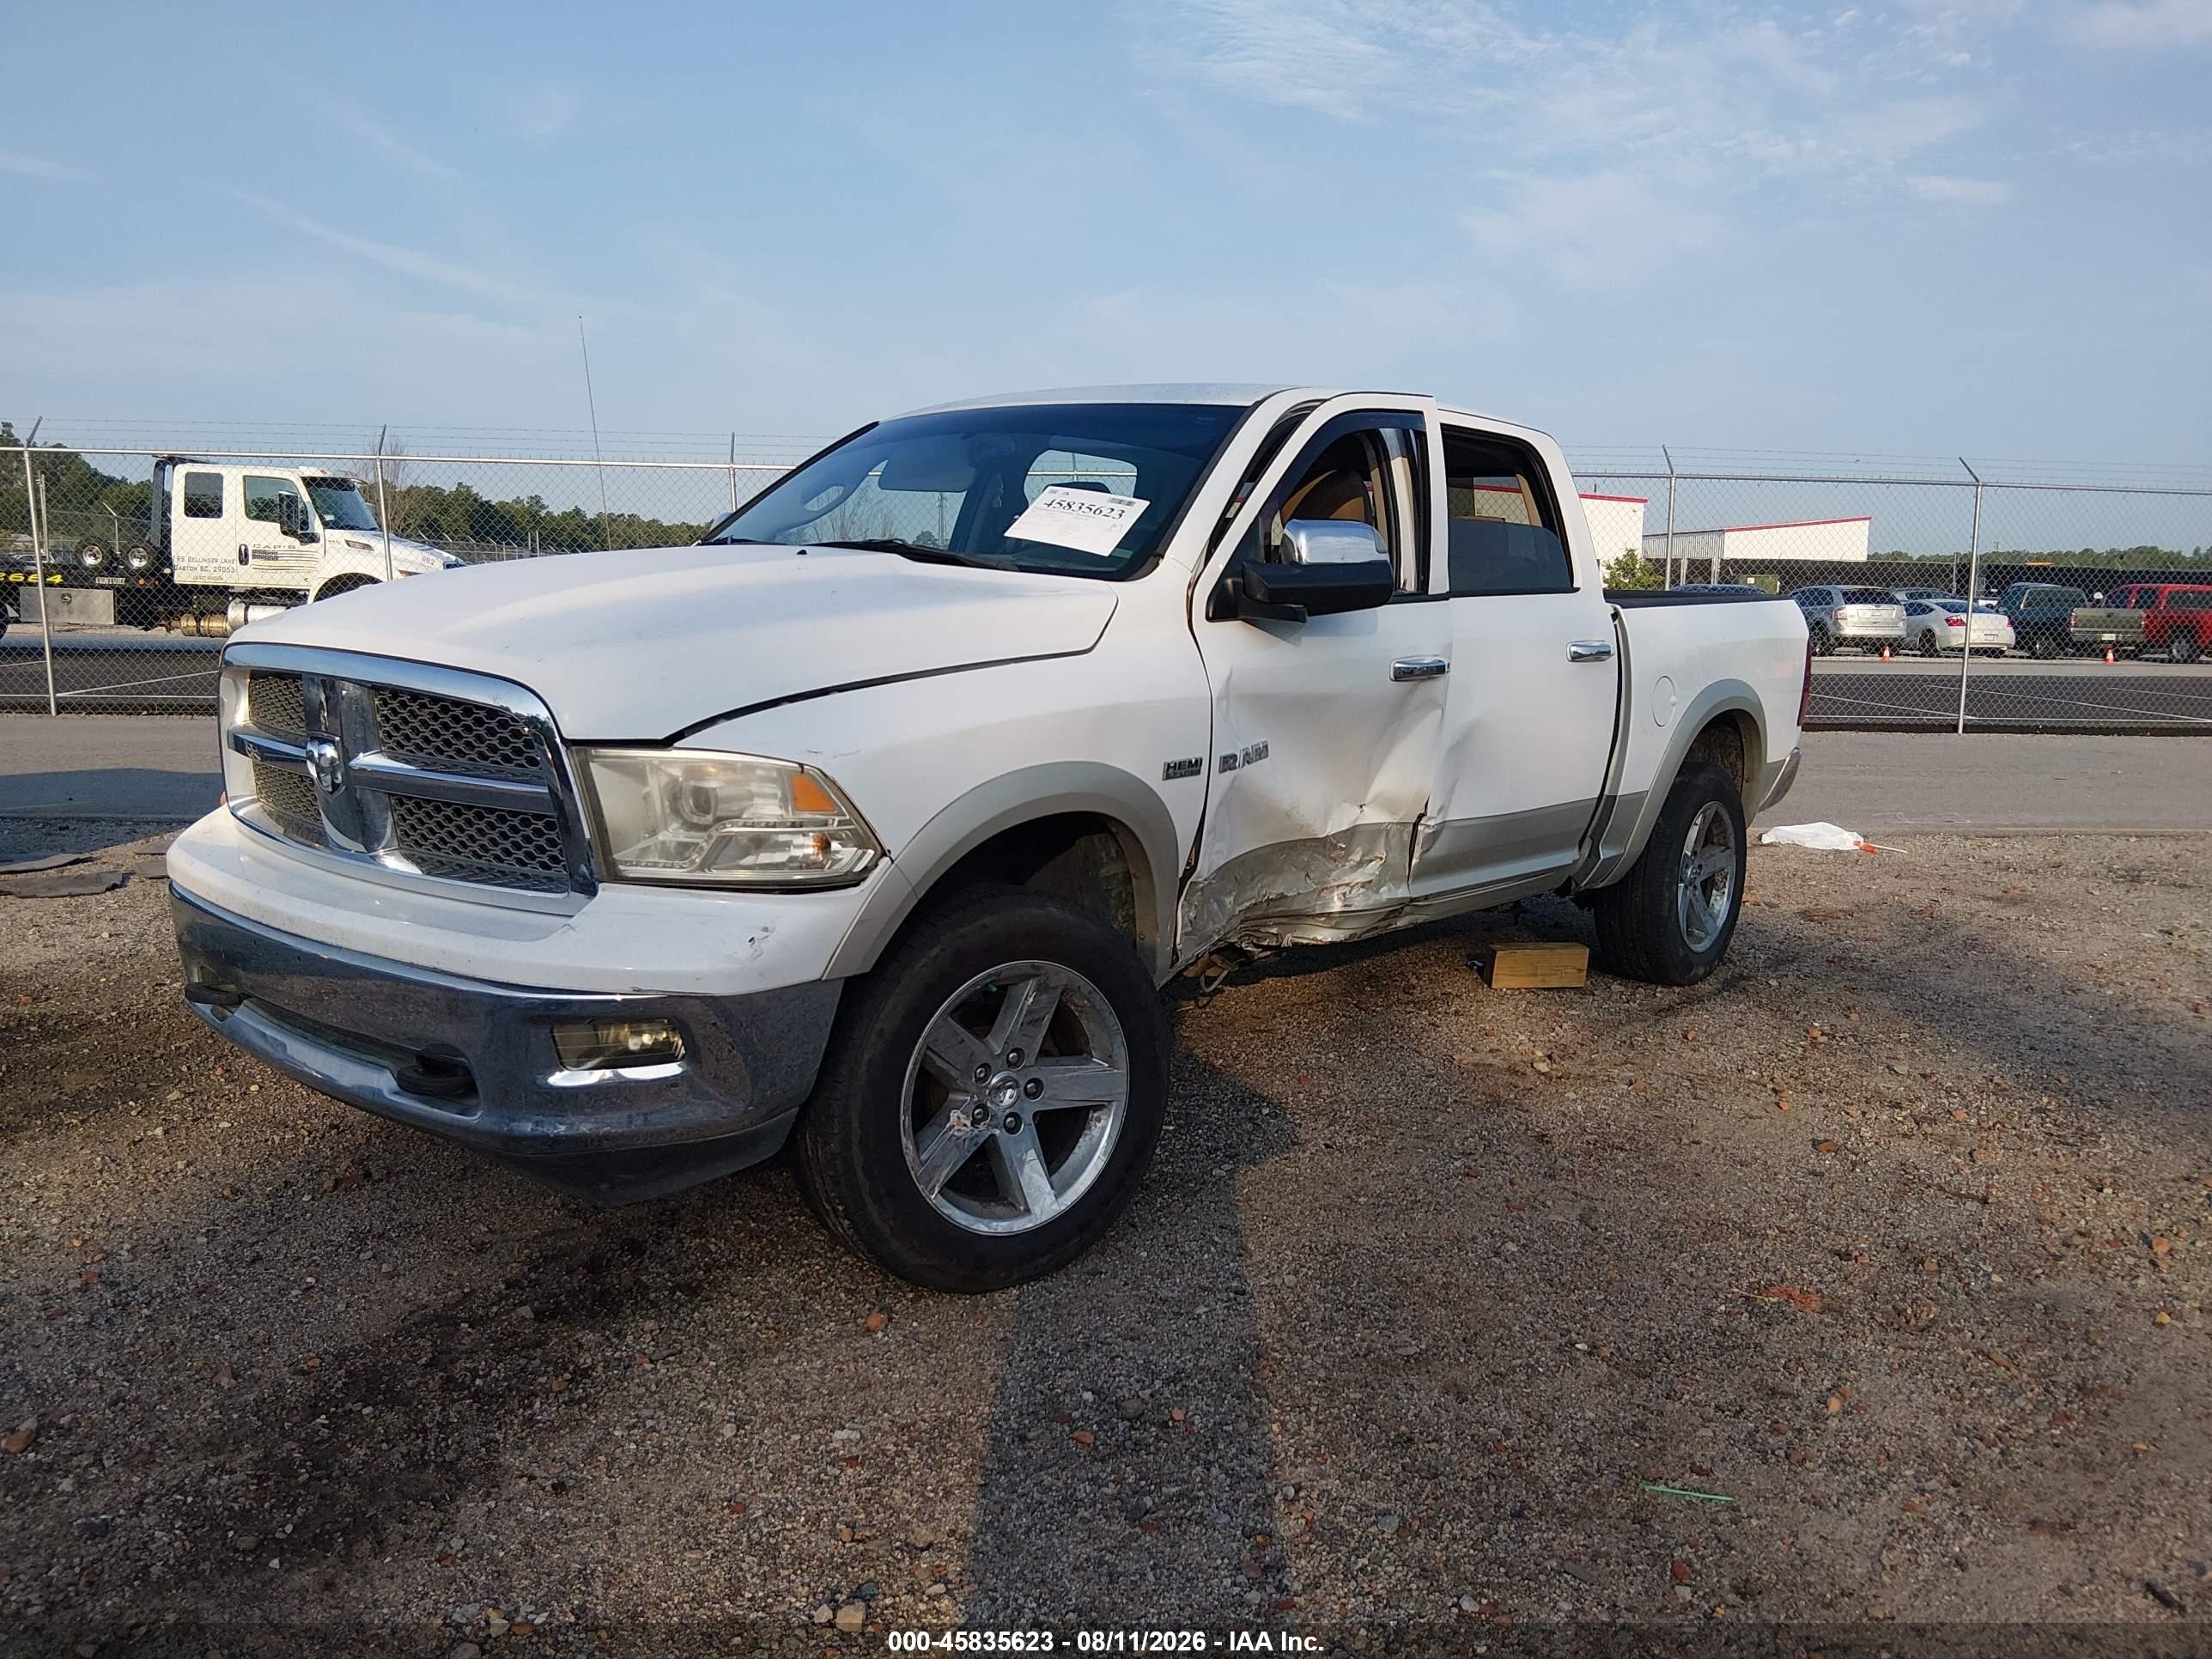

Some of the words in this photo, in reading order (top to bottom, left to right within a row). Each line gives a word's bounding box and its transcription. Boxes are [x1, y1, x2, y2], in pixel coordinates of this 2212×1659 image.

[1044, 498, 1126, 520] 45835623
[1166, 757, 1203, 772] HEMI
[1218, 740, 1269, 774] RAM
